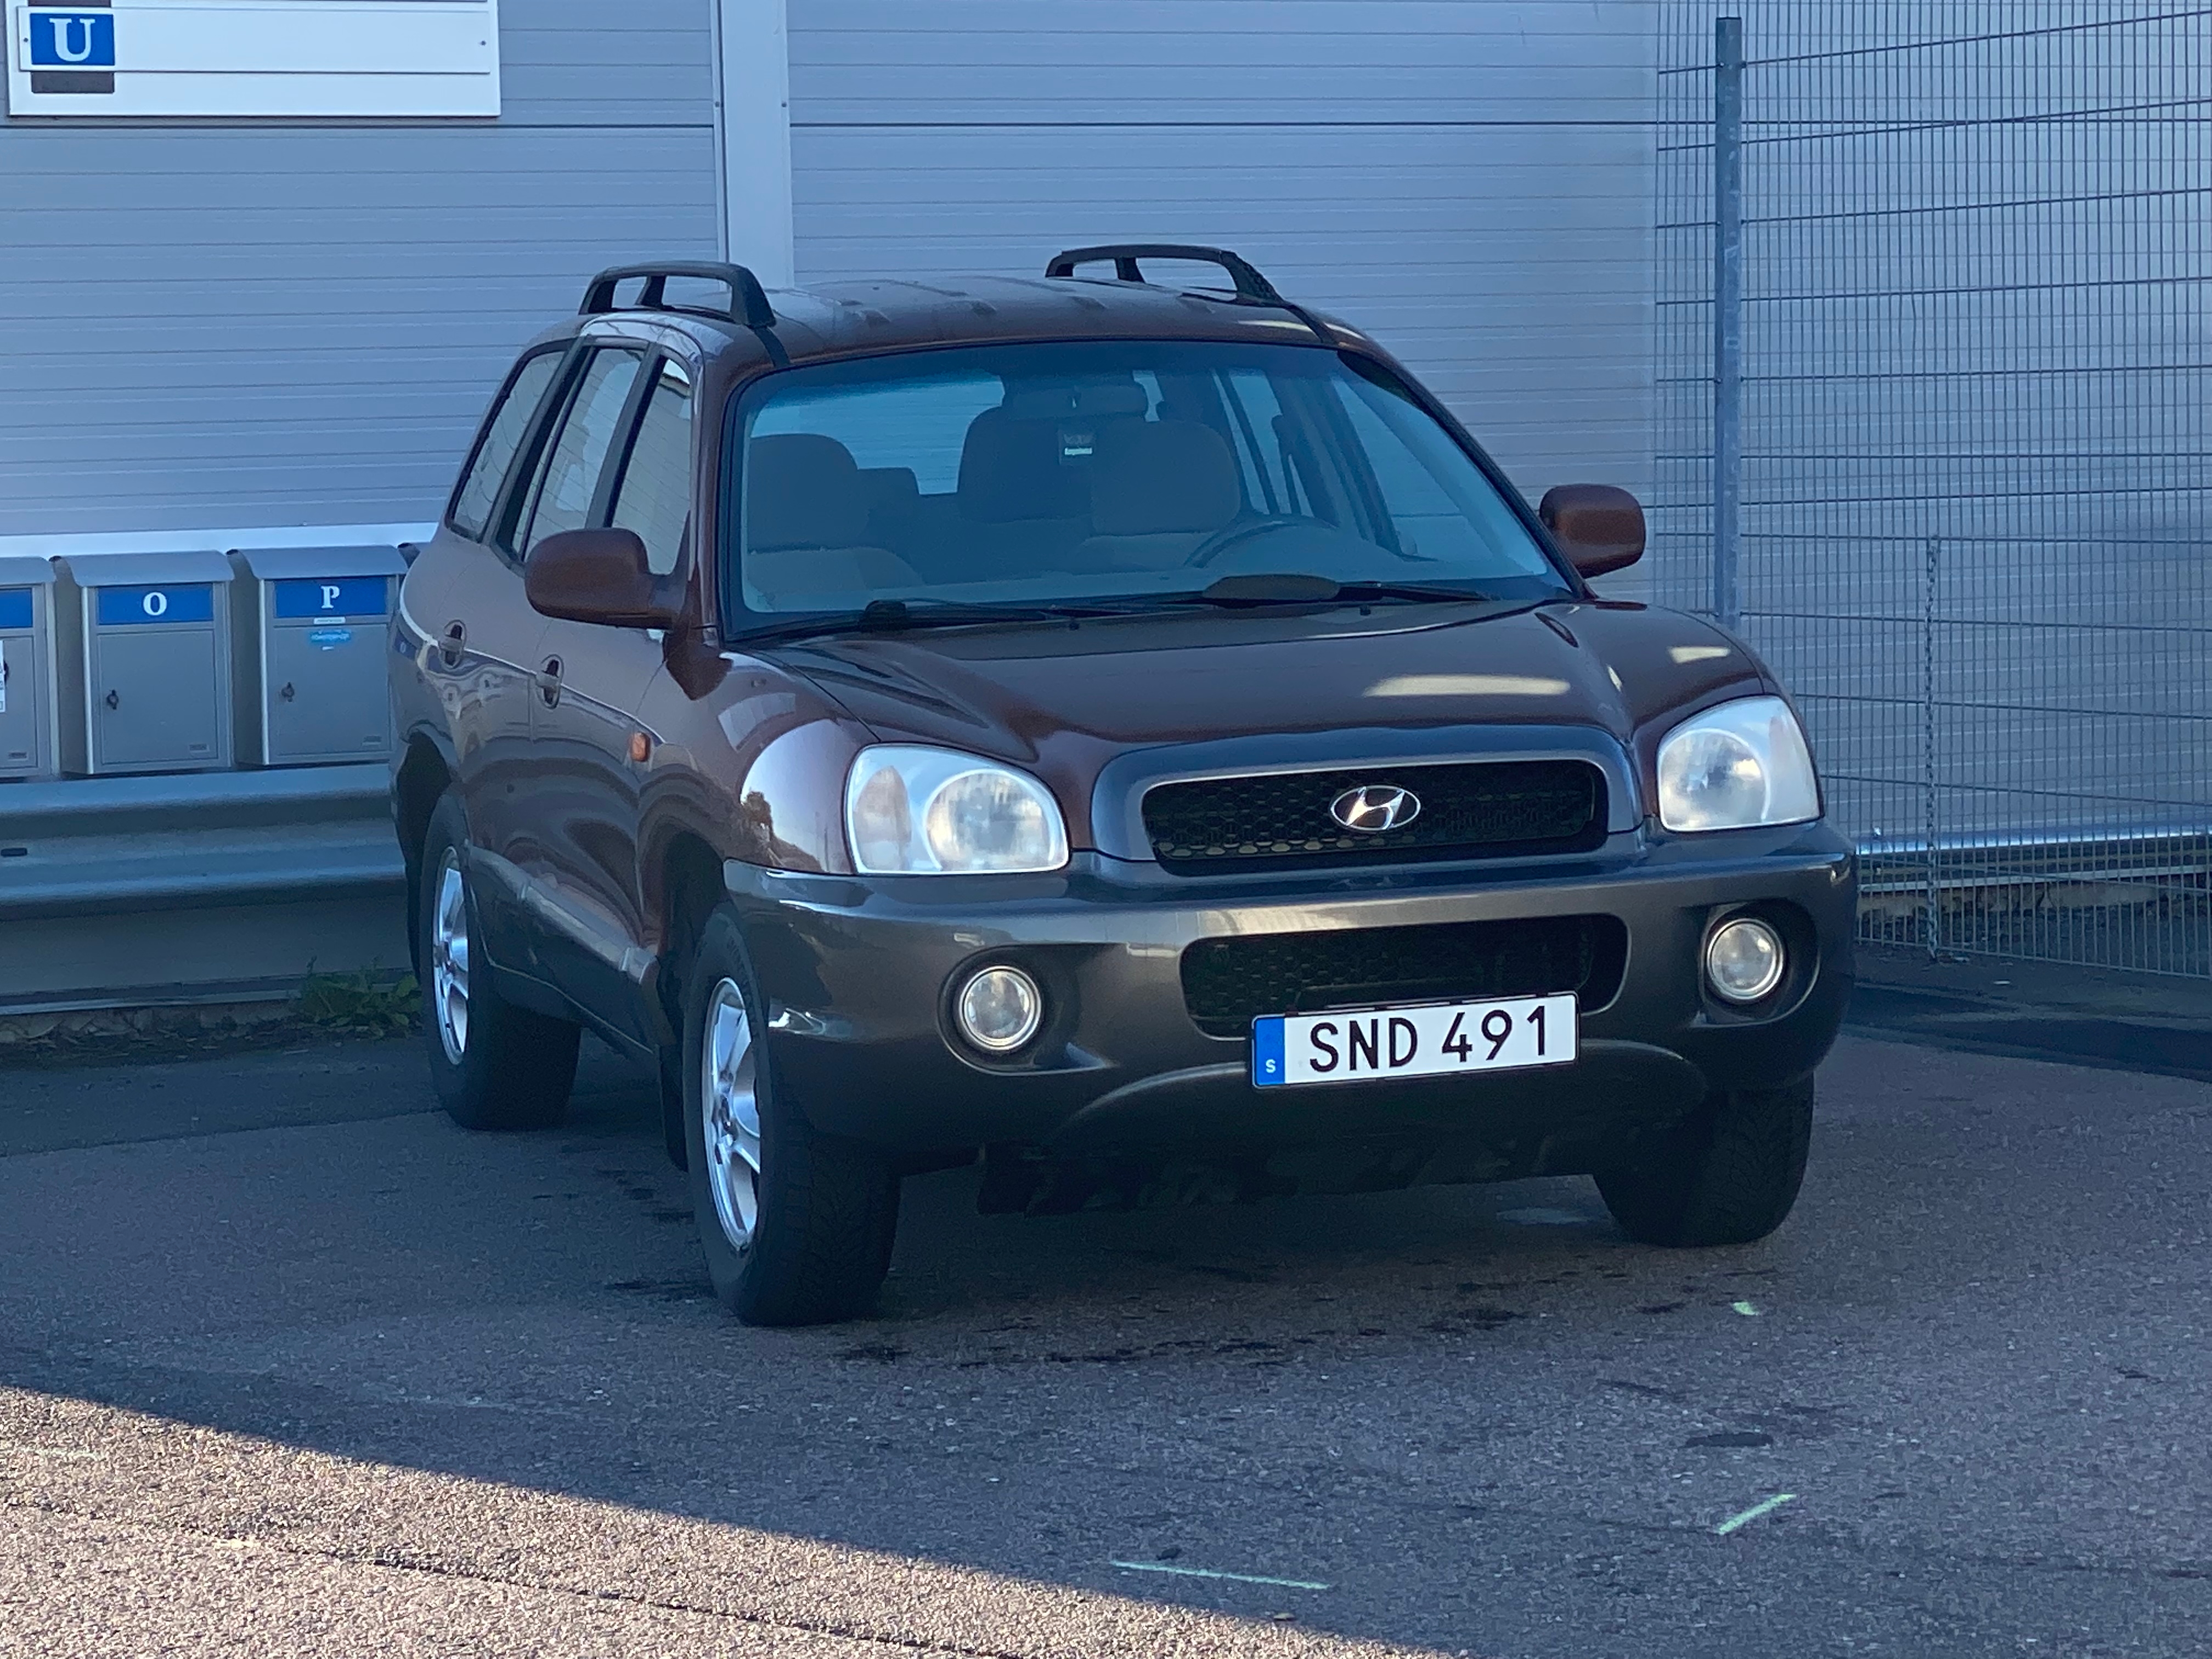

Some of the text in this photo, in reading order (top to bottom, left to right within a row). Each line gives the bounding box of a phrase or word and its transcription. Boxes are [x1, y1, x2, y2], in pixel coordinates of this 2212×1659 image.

[49, 18, 95, 61] U
[143, 591, 167, 616] O
[321, 585, 340, 609] P
[1309, 1005, 1546, 1073] SND 491
[1265, 1059, 1276, 1073] S
